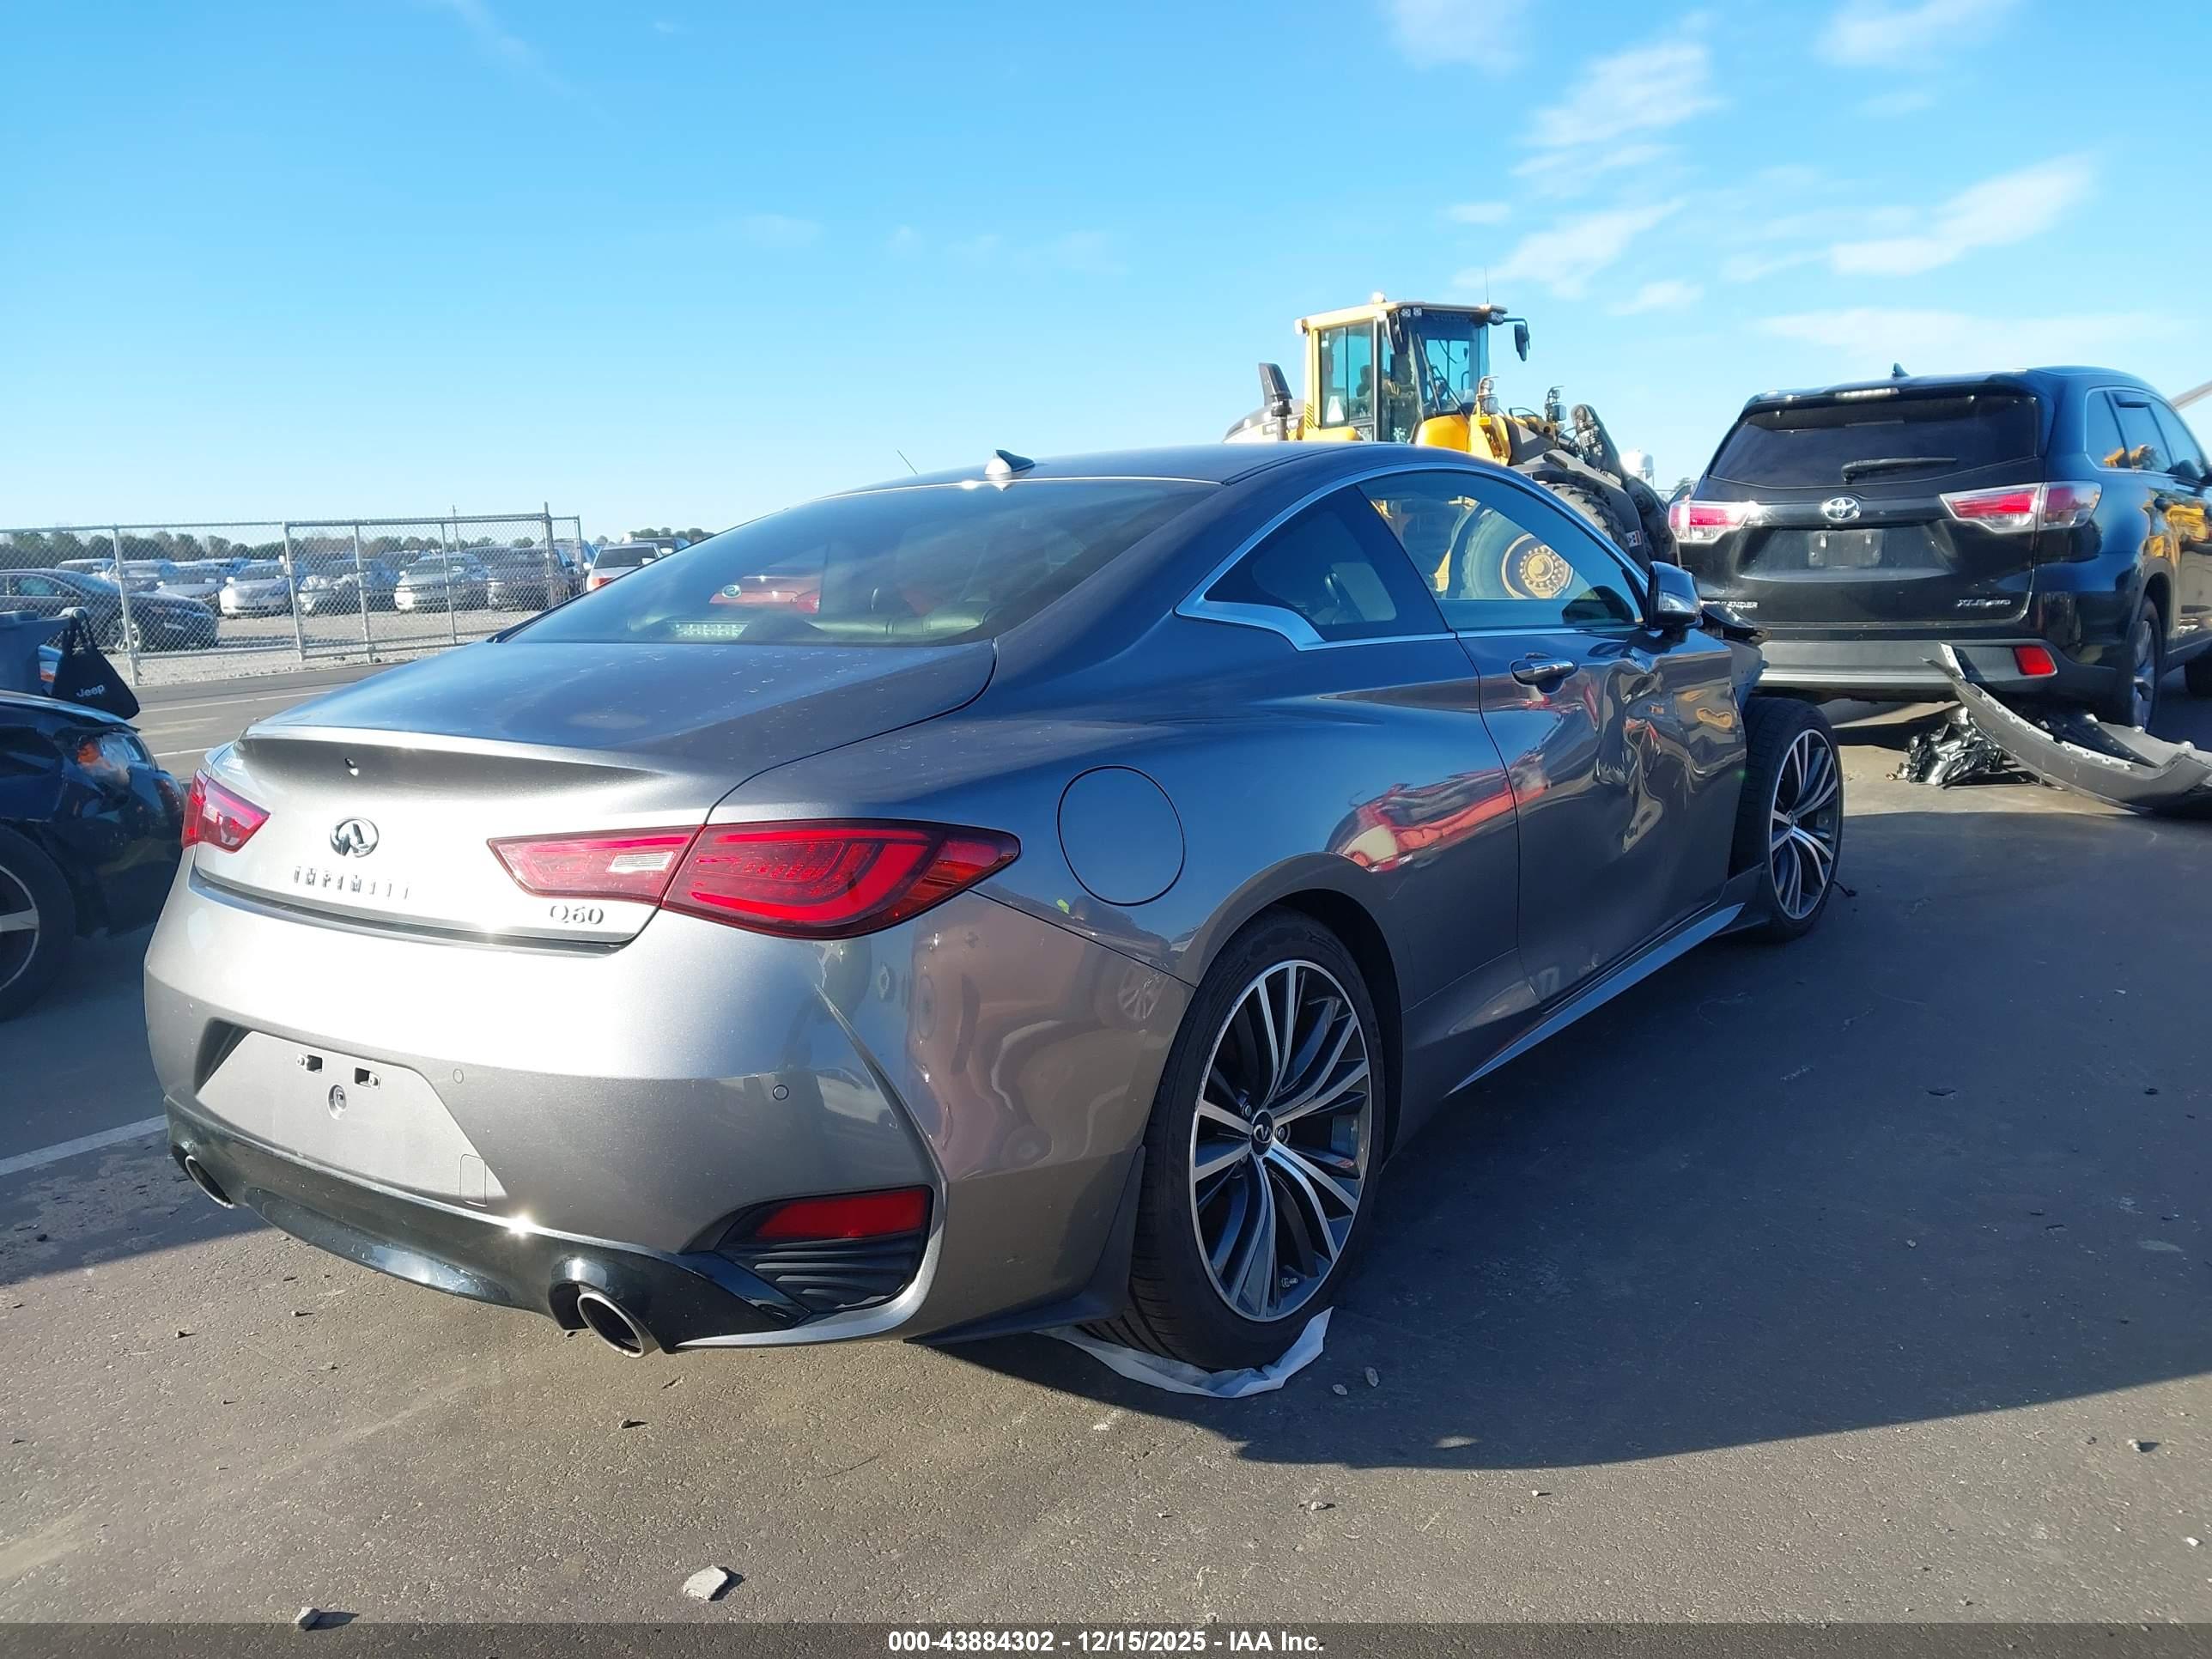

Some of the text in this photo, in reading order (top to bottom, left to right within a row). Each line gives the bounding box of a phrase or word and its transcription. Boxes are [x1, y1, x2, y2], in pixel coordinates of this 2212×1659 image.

[76, 684, 105, 697] Jeep
[294, 866, 410, 900] INFINITI
[550, 905, 604, 925] Q60
